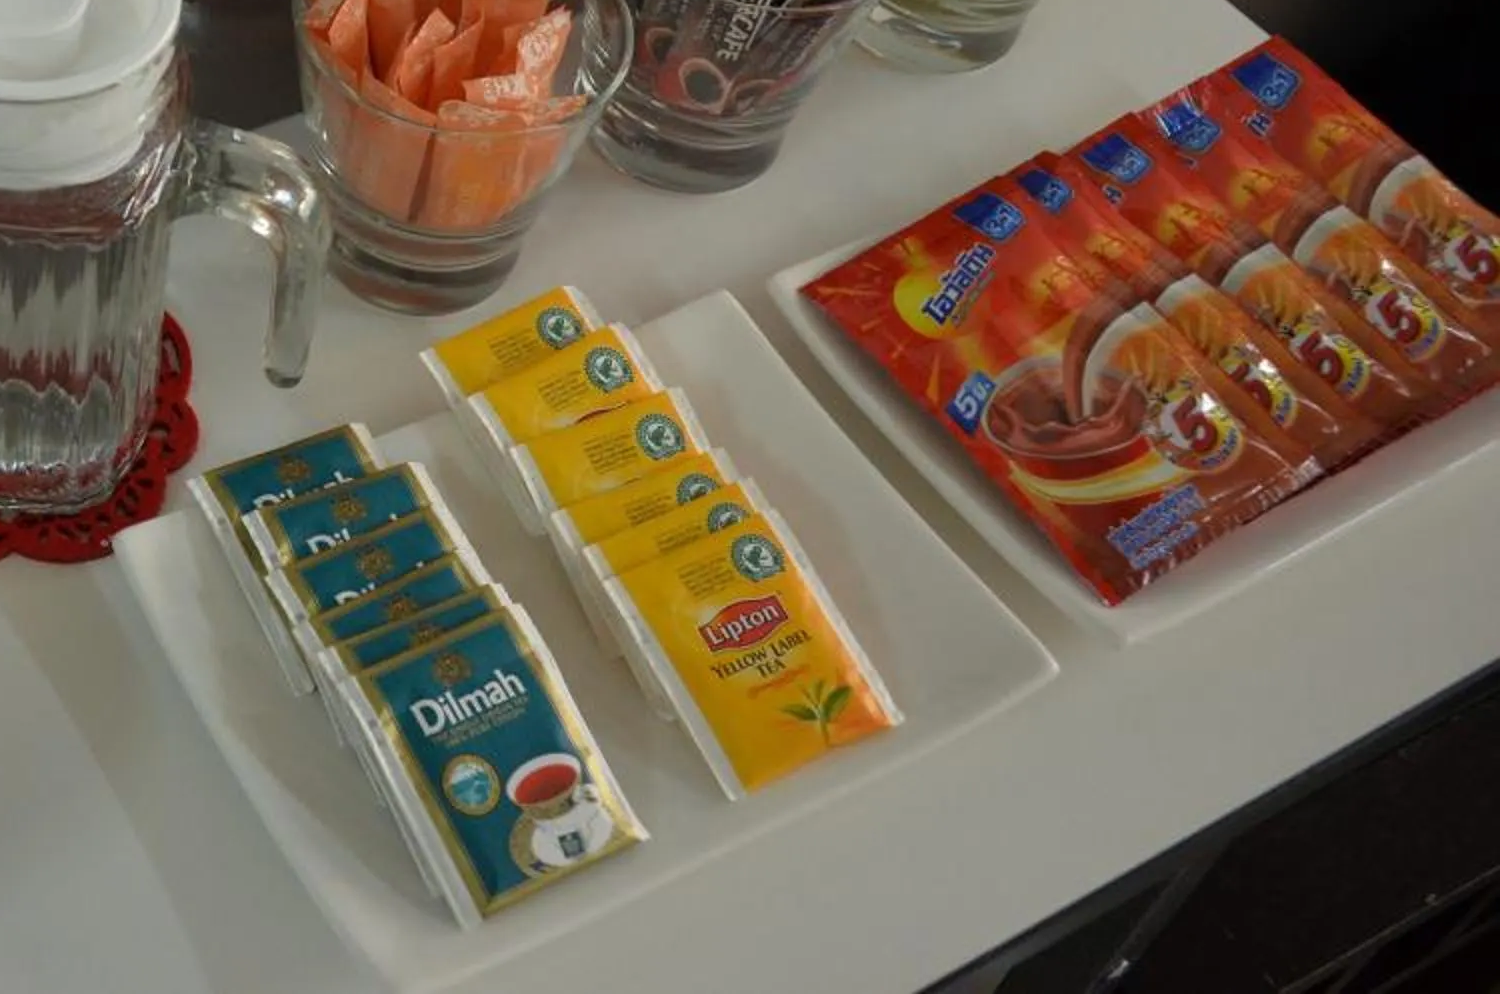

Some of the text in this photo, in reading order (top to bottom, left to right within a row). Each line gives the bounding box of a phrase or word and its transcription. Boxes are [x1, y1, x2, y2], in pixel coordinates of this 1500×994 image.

[705, 605, 779, 645] Lipton
[710, 629, 812, 679] YELLOW LABEL
[756, 658, 787, 679] TEA
[409, 668, 527, 738] Dilmah
